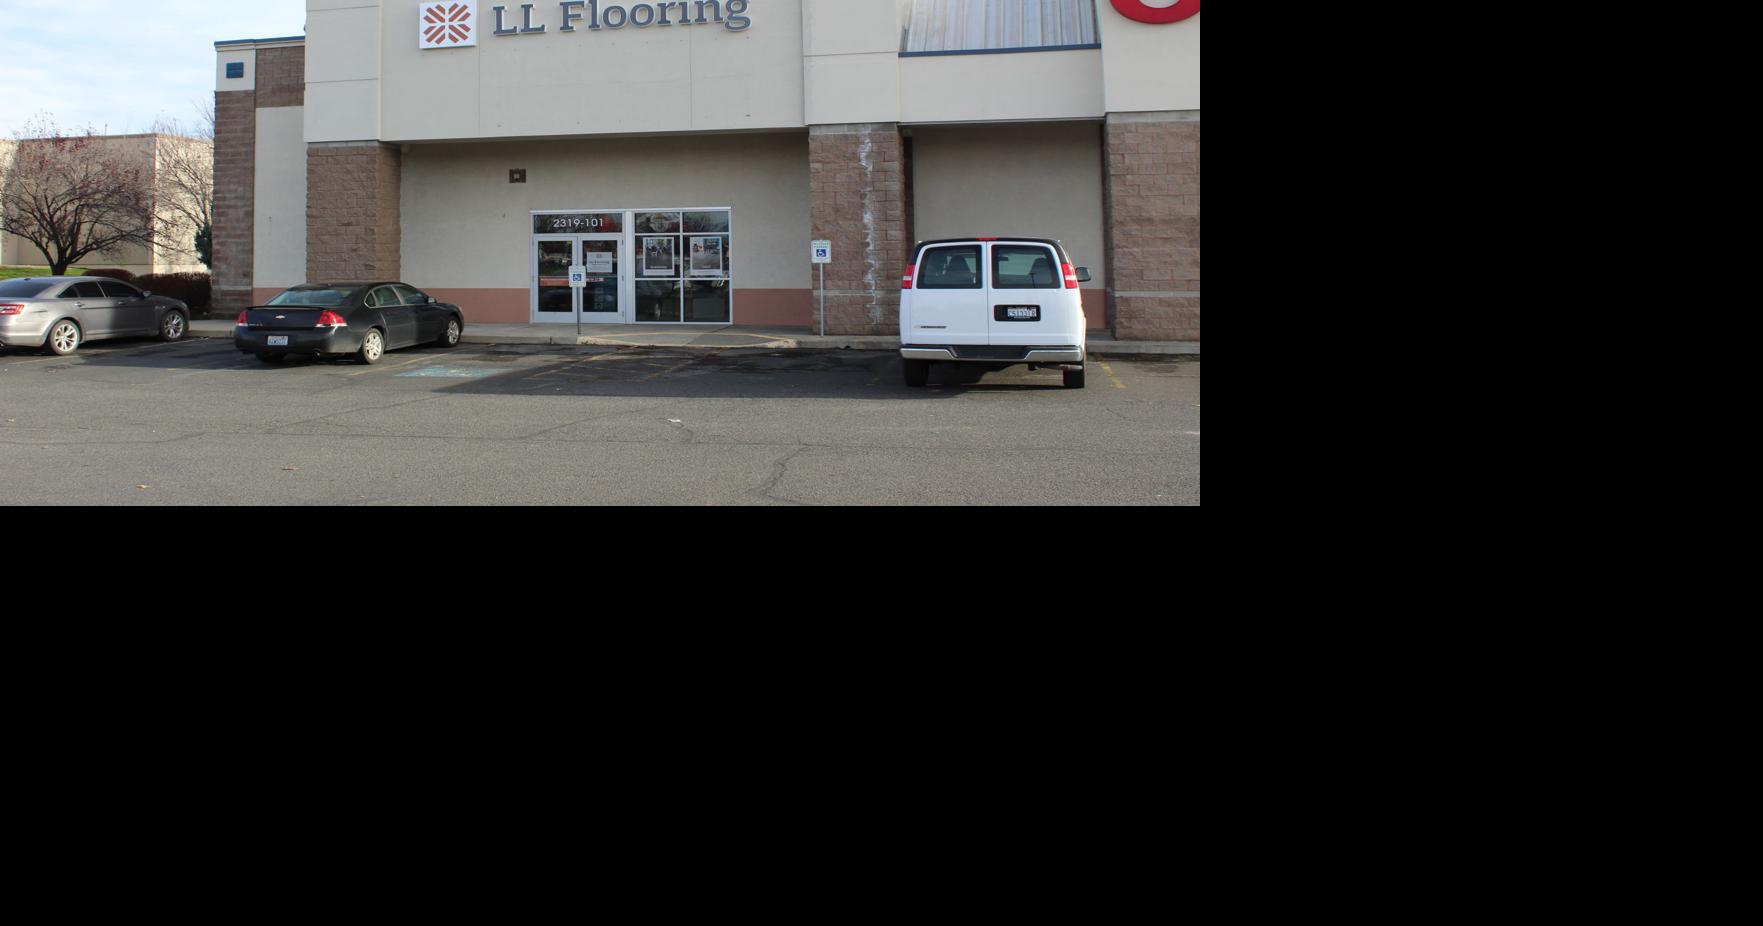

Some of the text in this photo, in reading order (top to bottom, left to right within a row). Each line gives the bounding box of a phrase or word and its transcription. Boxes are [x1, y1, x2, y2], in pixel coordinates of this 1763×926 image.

[493, 0, 752, 36] LL Flooring
[553, 218, 603, 228] 2319-101
